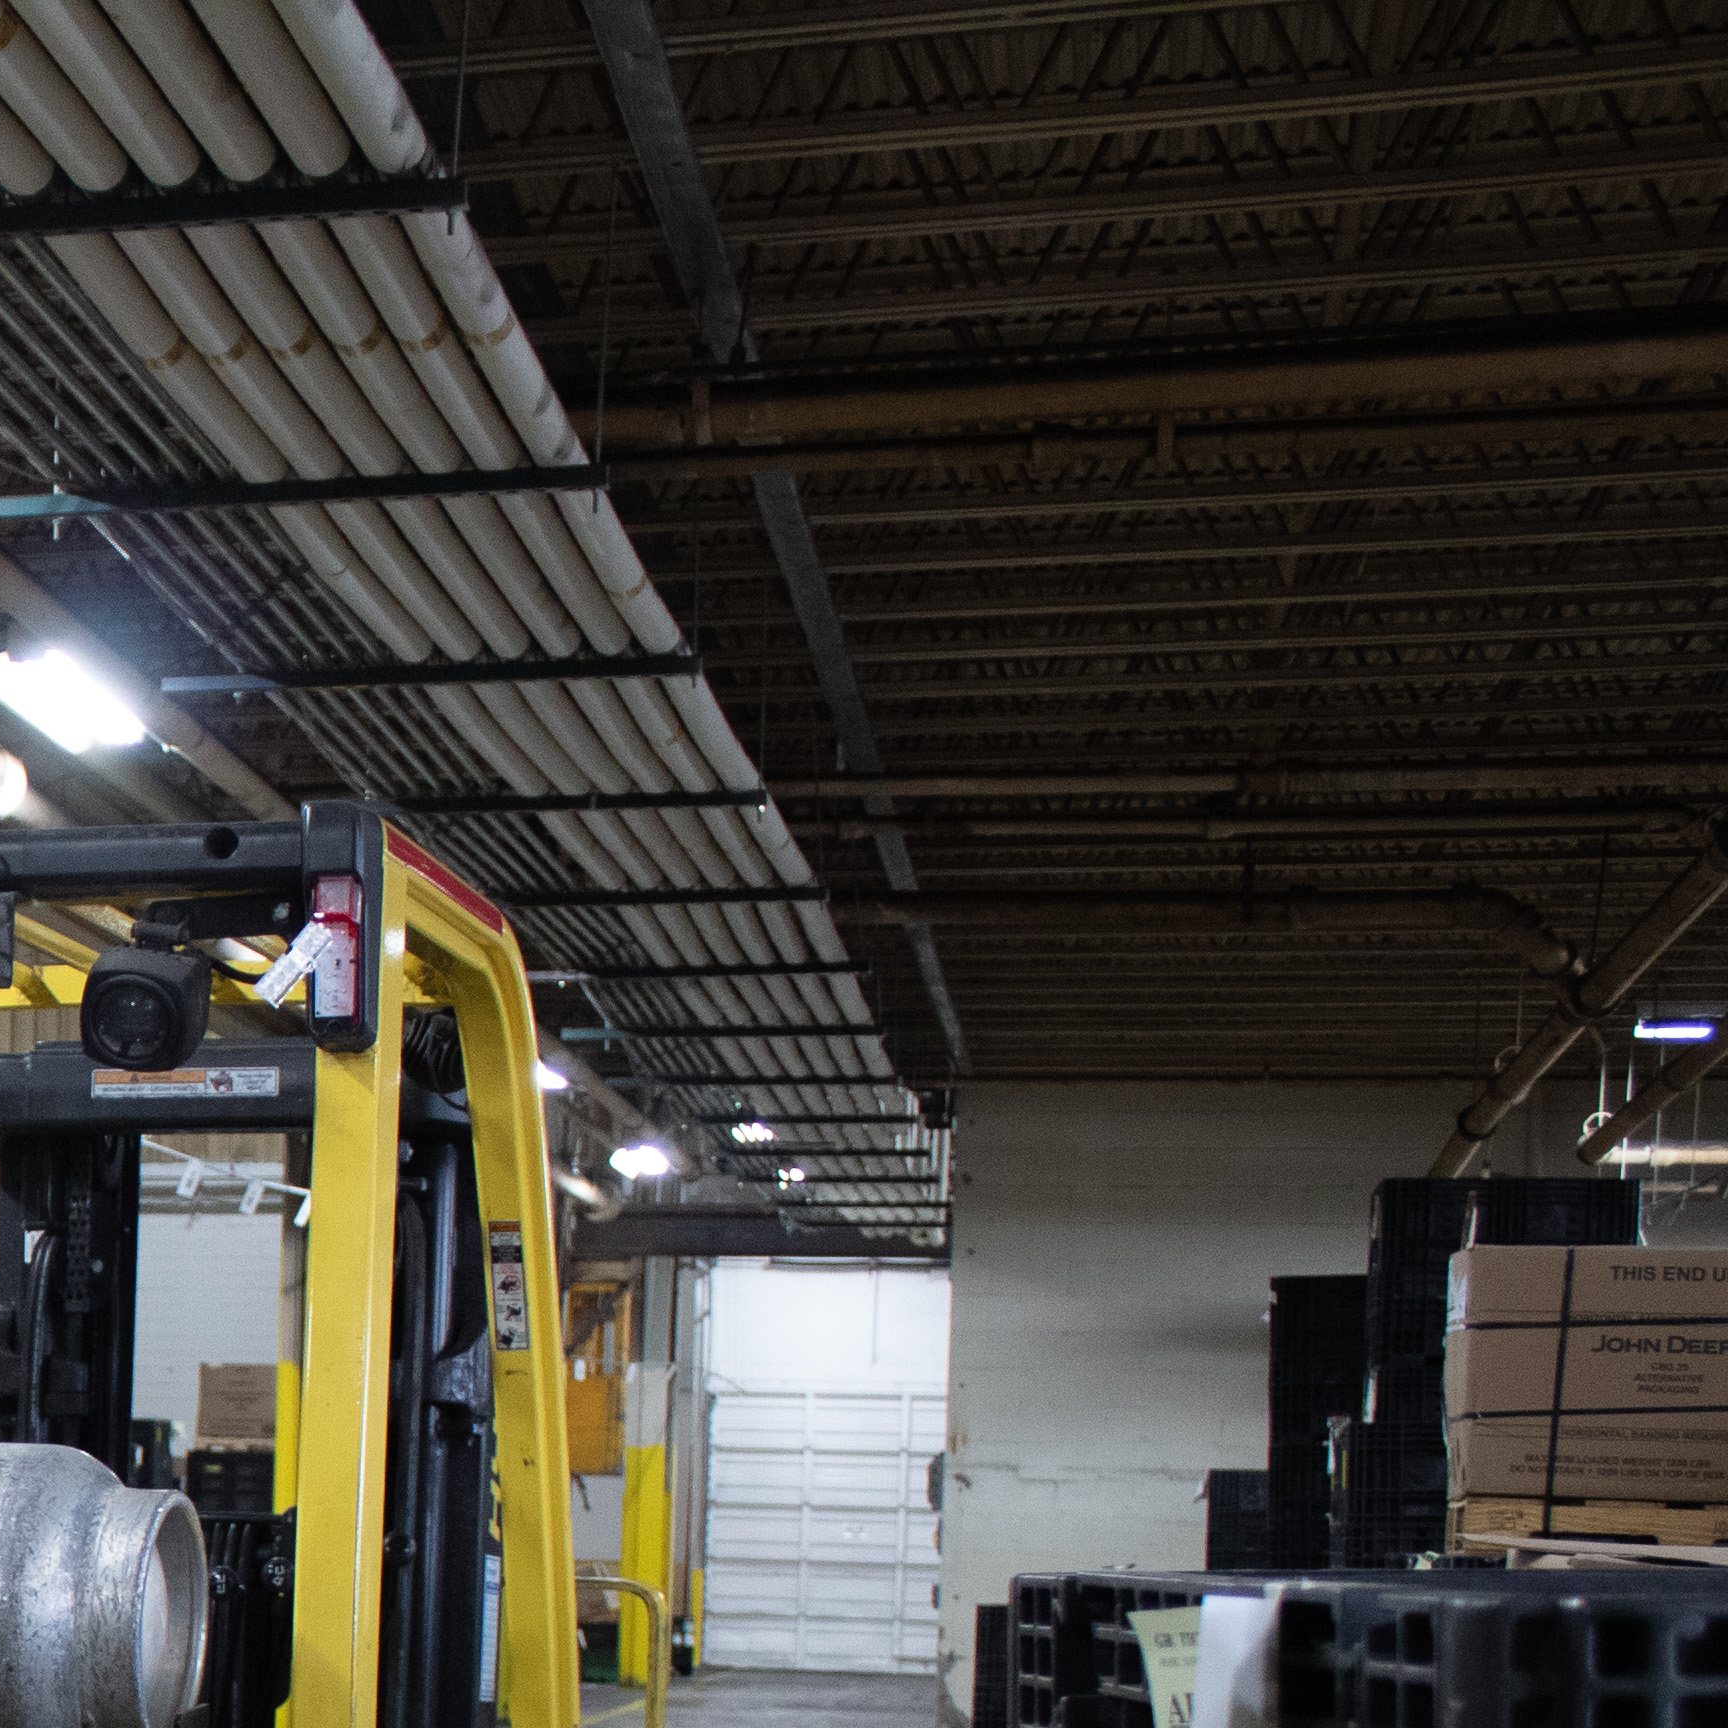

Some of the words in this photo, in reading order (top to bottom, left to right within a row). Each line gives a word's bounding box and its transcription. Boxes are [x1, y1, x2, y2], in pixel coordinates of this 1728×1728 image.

[1609, 1265, 1656, 1281] THIS
[1661, 1265, 1706, 1281] END
[1712, 1265, 1728, 1281] U
[1590, 1334, 1661, 1354] JOHN
[1666, 1335, 1728, 1355] DEER
[1634, 1373, 1705, 1383] ALTERNATIVE
[1636, 1384, 1700, 1394] PACKAGING
